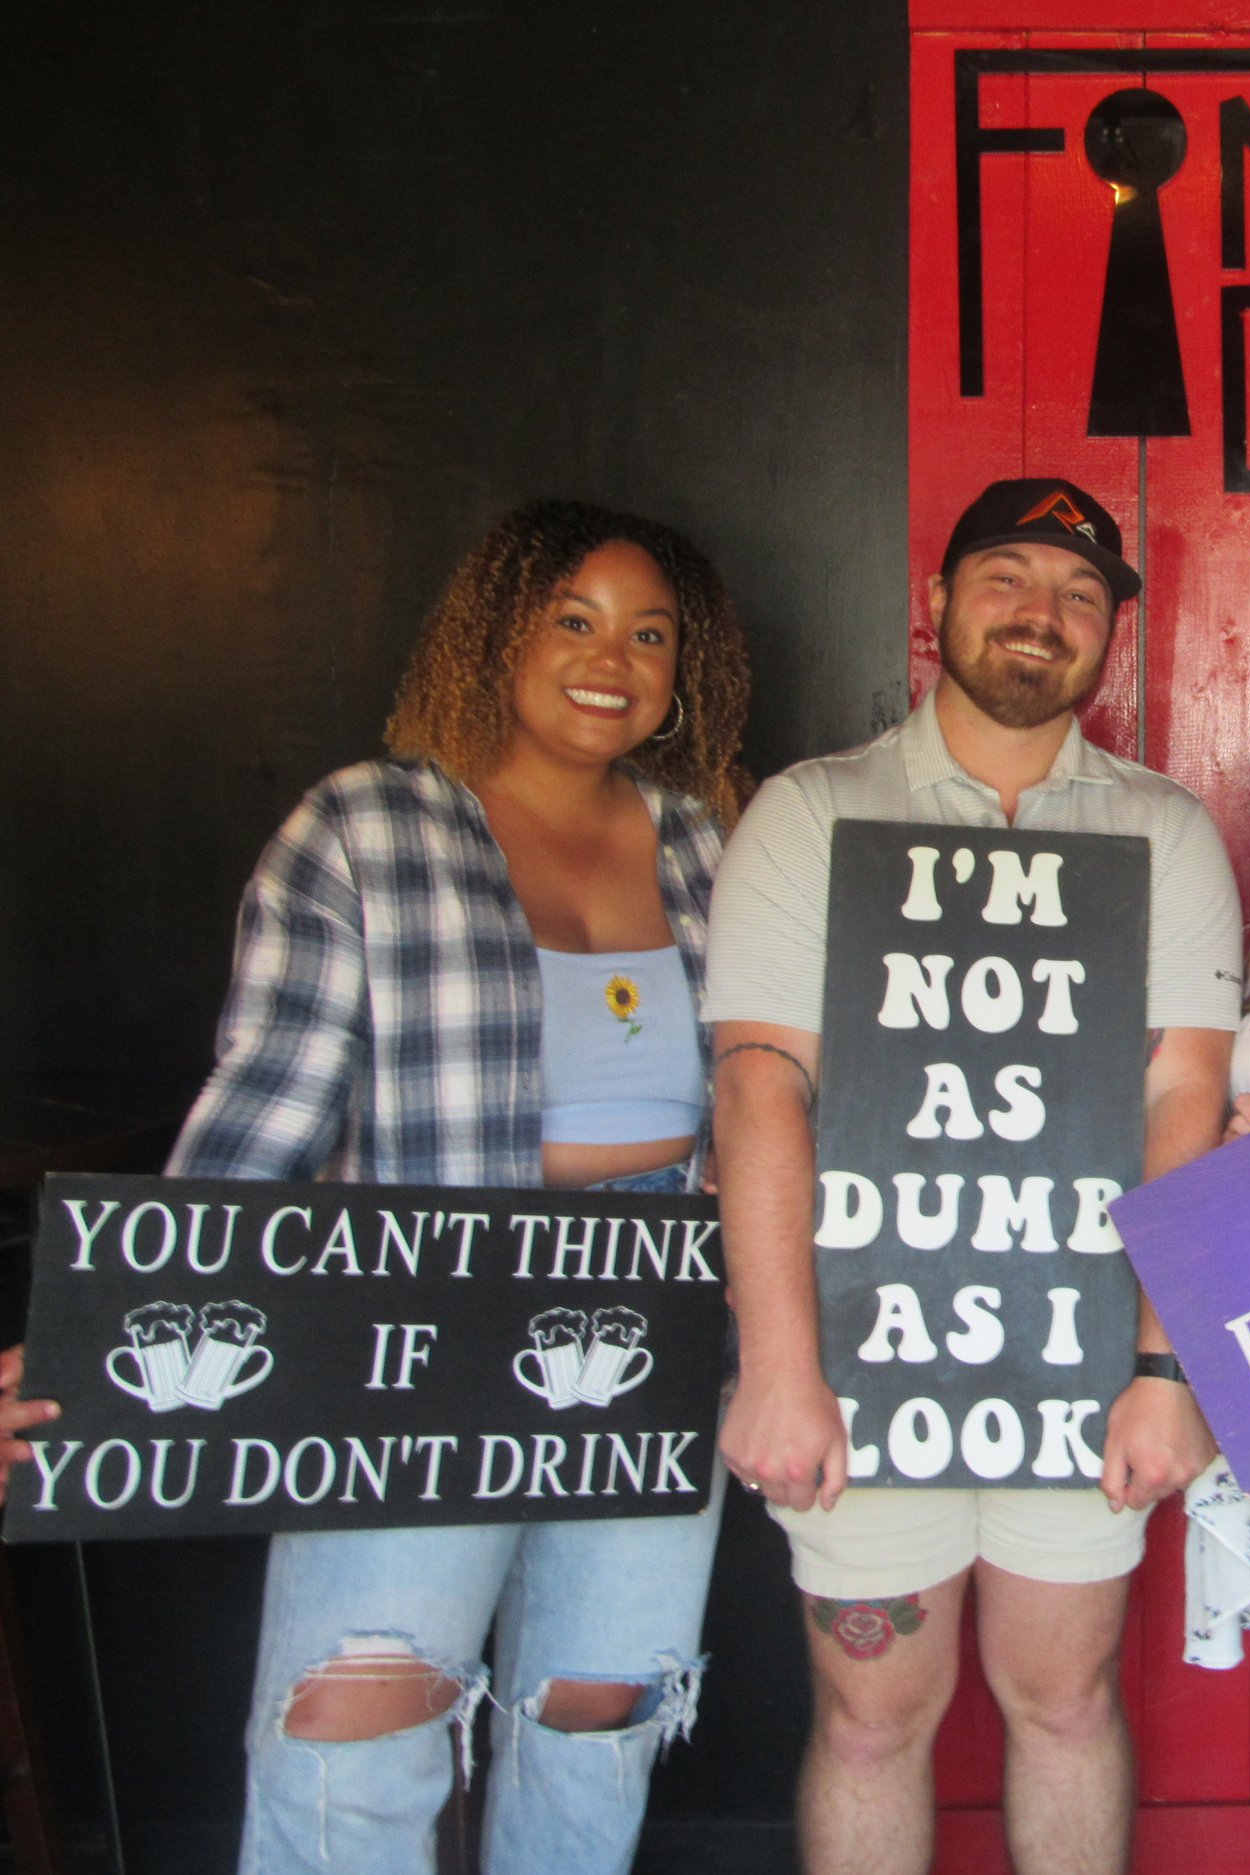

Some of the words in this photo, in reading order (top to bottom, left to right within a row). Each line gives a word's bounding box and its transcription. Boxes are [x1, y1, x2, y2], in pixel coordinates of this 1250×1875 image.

[901, 847, 1068, 927] I'M
[878, 953, 1086, 1035] NOT
[906, 1063, 1046, 1141] AS
[62, 1200, 244, 1275] YOU
[261, 1205, 491, 1278] CAN'T
[509, 1214, 721, 1282] THINK
[814, 1170, 1125, 1254] DUMB
[364, 1324, 438, 1390] IF
[857, 1283, 1005, 1365] AS
[1041, 1287, 1084, 1365] I
[28, 1438, 208, 1511] YOU
[224, 1435, 458, 1505] DON'T
[472, 1431, 699, 1499] DRINK
[837, 1396, 1104, 1479] LOOK
